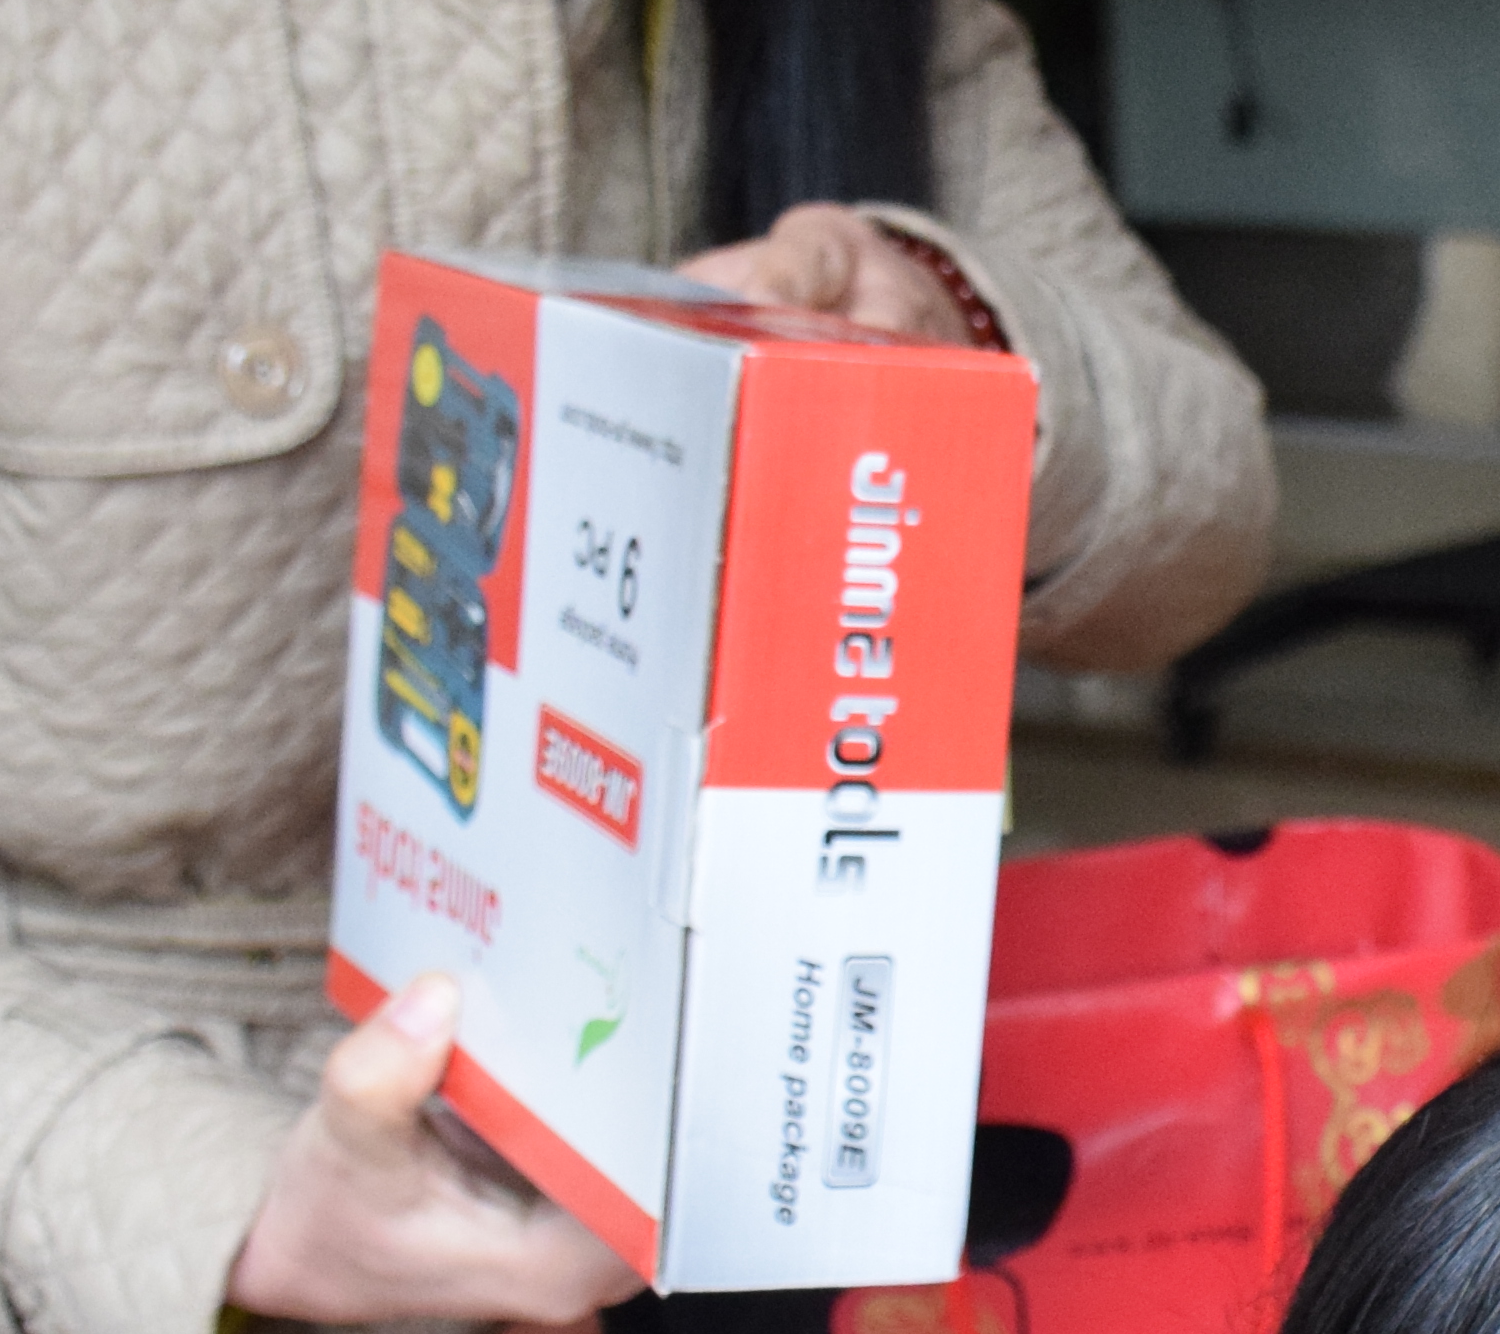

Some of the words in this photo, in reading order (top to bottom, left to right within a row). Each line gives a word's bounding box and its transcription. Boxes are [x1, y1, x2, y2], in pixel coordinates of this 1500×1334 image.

[573, 516, 615, 579] PC
[618, 533, 641, 620] 9
[817, 695, 900, 897] tools
[788, 958, 823, 1065] Home
[836, 976, 879, 1173] JM-8009E
[769, 1072, 809, 1227] package
